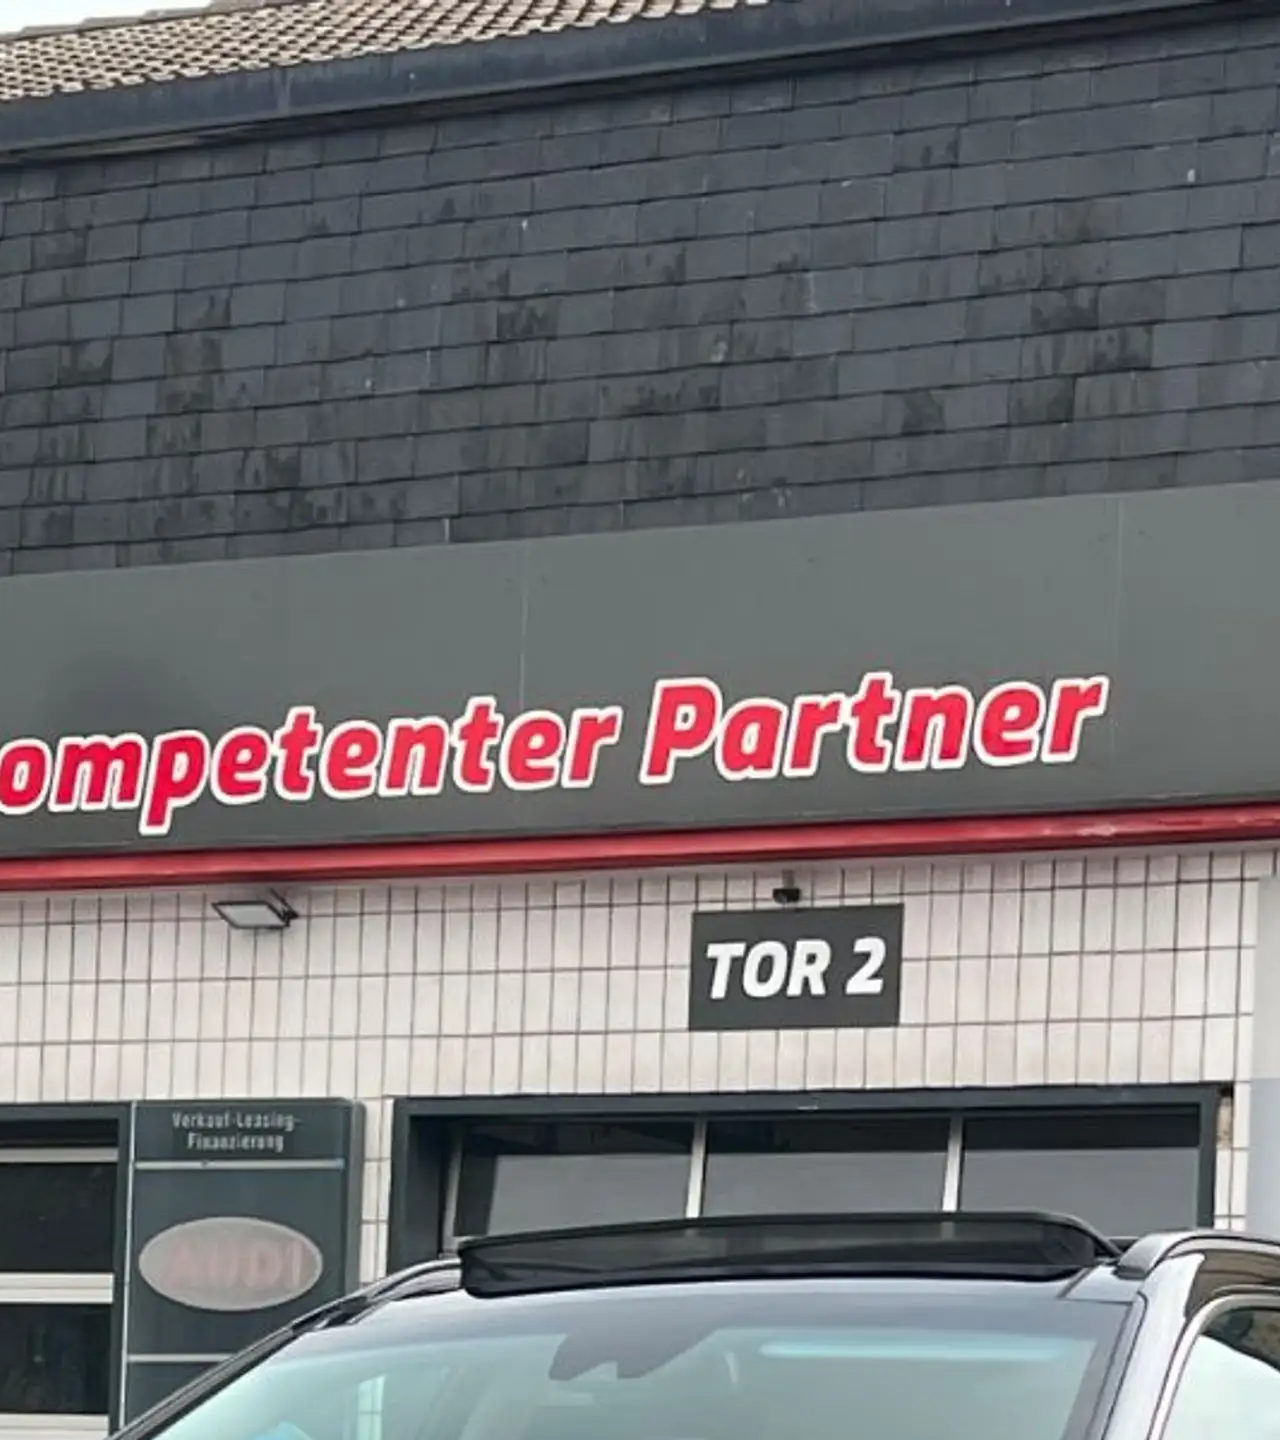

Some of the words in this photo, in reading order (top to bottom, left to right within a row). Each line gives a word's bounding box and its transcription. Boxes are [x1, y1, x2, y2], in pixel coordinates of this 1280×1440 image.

[639, 670, 1109, 785] Partner
[705, 940, 827, 998] TOR
[846, 937, 887, 994] 2
